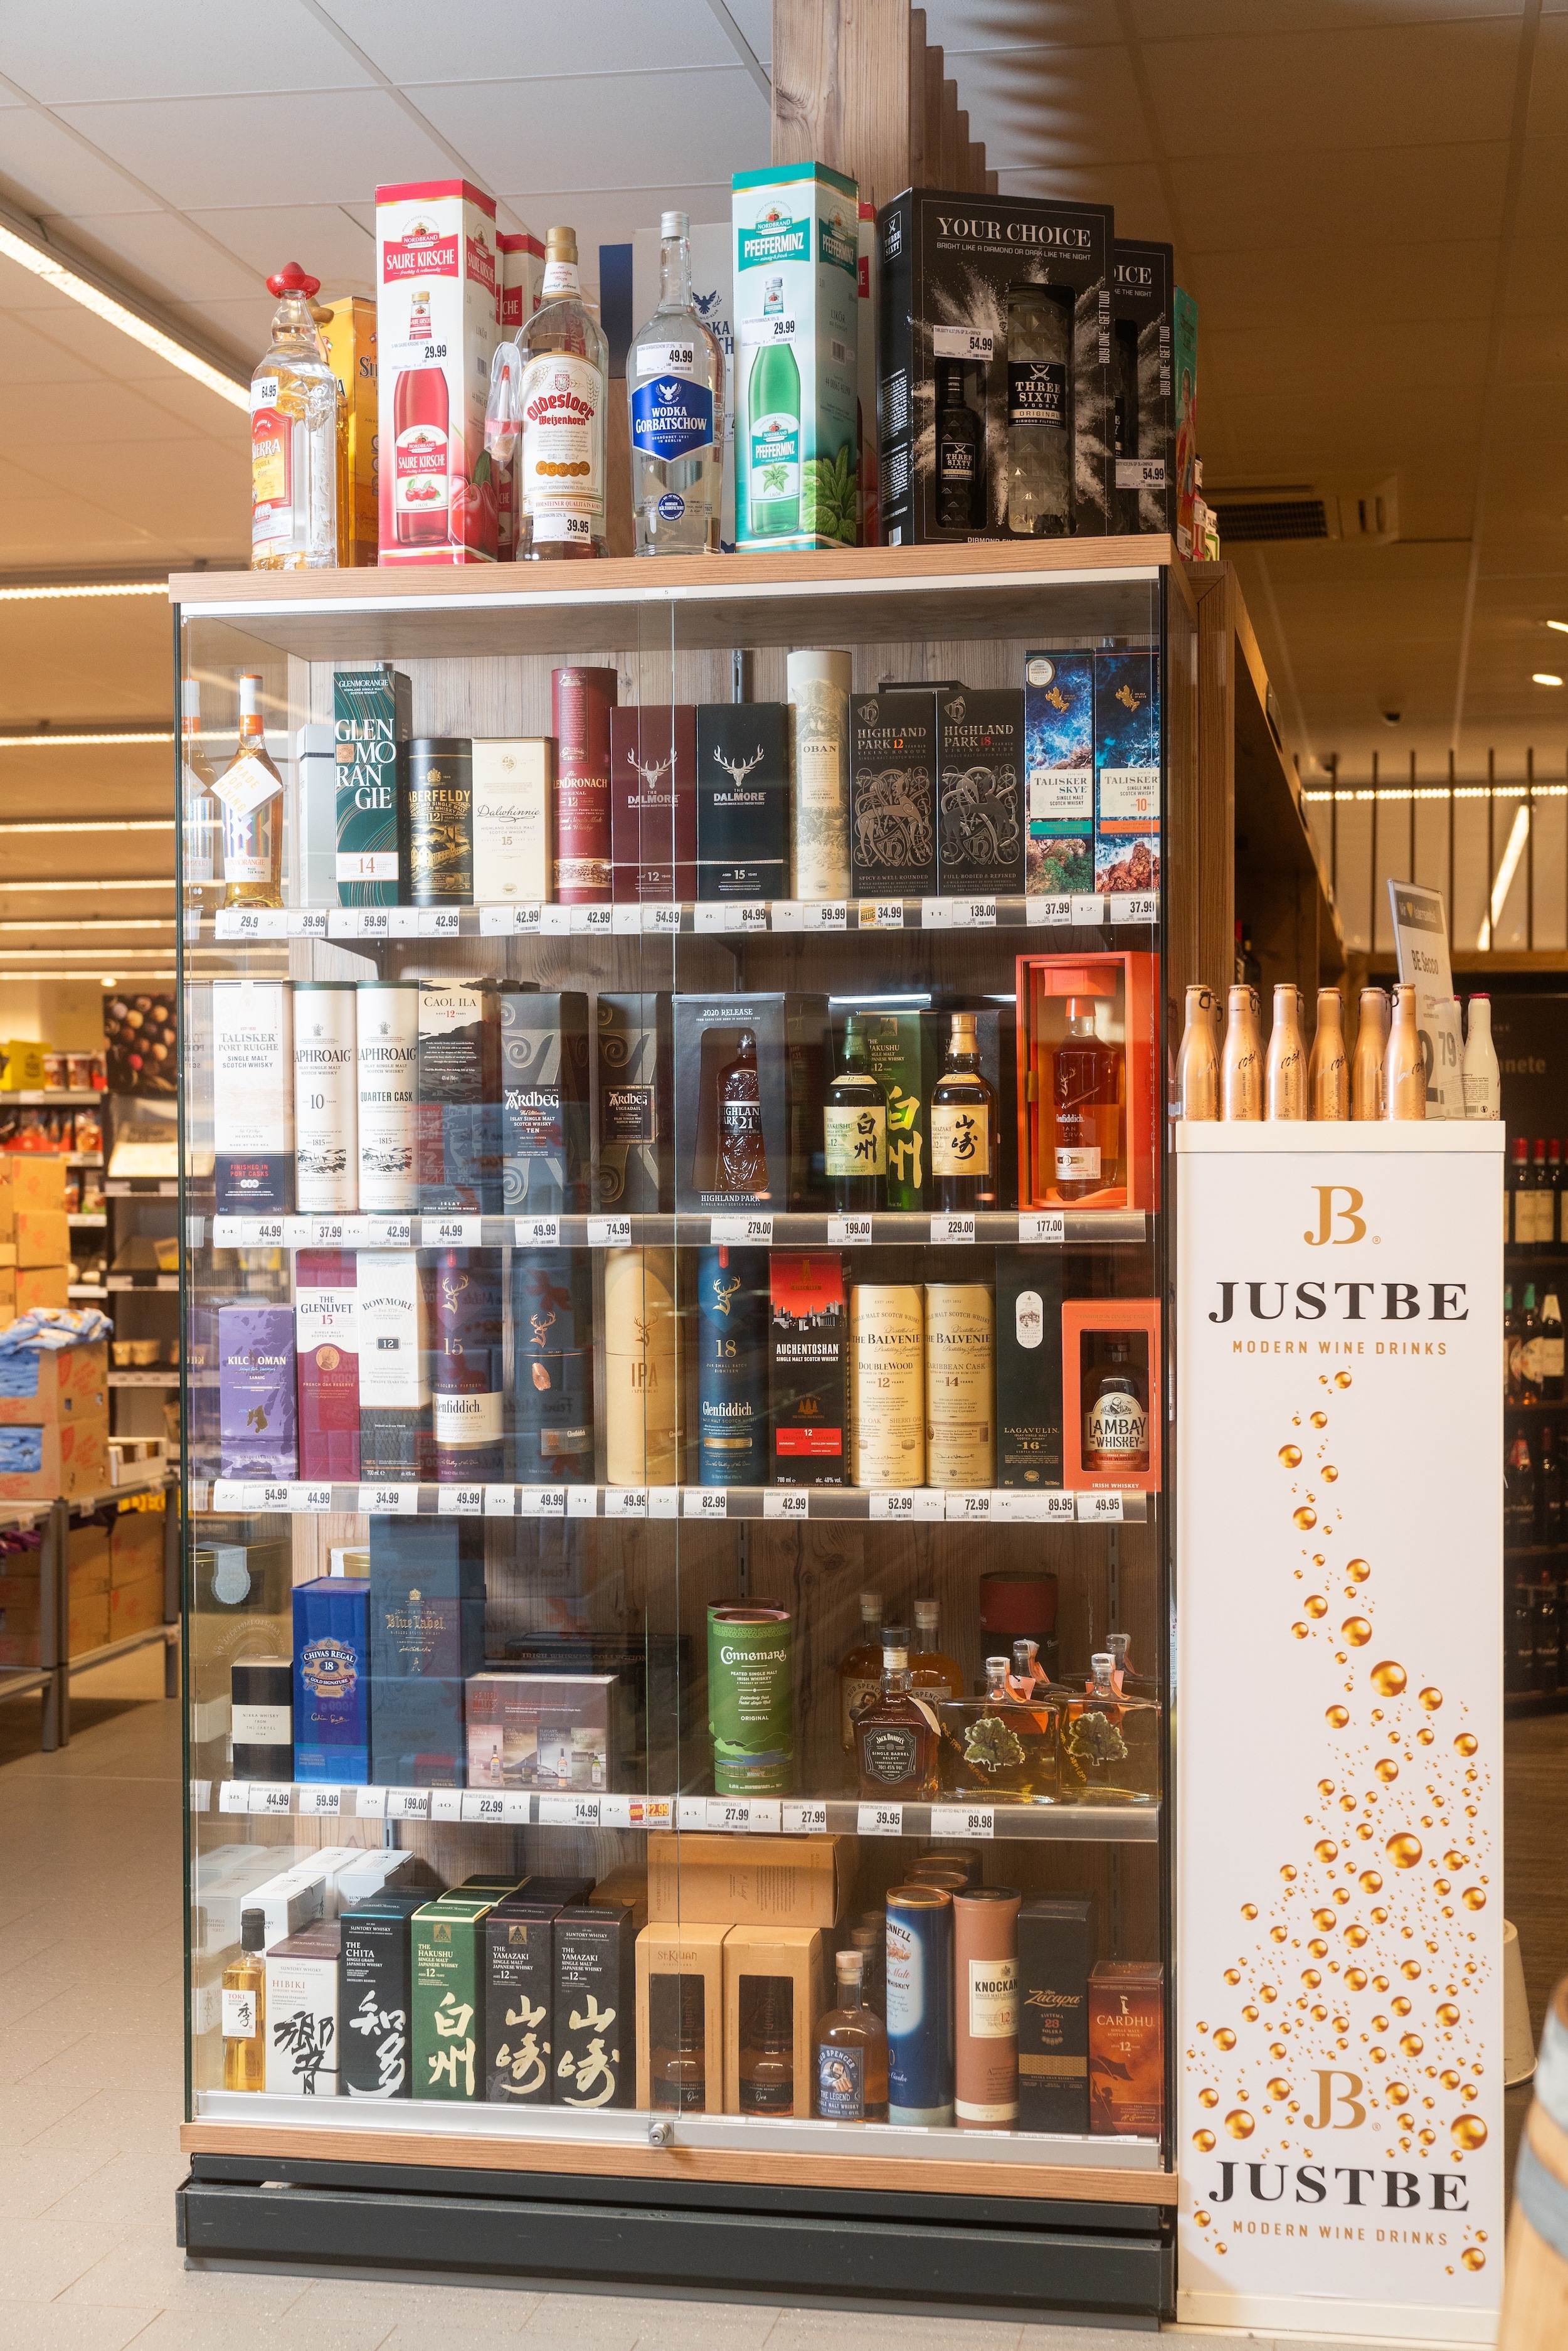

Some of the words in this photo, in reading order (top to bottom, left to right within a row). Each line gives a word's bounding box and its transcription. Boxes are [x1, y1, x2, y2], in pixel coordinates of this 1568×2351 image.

[757, 220, 791, 230] NORDBRAND
[937, 218, 1001, 240] YOUR
[1007, 224, 1091, 247] CHOICE
[403, 235, 438, 243] NORDBRAND
[744, 233, 803, 258] PFEFFERMINZ
[985, 245, 1013, 253] DIAMOND
[1073, 252, 1091, 260] NIGHT
[387, 253, 415, 269] SAURE
[418, 250, 455, 266] KIRSCHE
[1099, 290, 1110, 307] TWO
[1099, 308, 1110, 324] GET
[775, 321, 795, 335] 29.99
[1099, 329, 1110, 346] ONE
[970, 337, 992, 351] 54.99
[425, 345, 447, 358] 29.99
[669, 350, 692, 364] 49.99
[1099, 346, 1110, 364] BUY
[262, 385, 277, 399] 64.95
[1016, 381, 1061, 393] THREE
[1019, 392, 1059, 404] SIXTY
[652, 407, 687, 417] WODKA
[636, 418, 707, 433] GORBATSCHOW
[567, 519, 589, 533] 39.95
[335, 719, 393, 741] GLEN
[857, 728, 926, 738] HIGHLAND
[858, 740, 890, 749] PARK
[893, 739, 904, 748] 12
[355, 742, 396, 763] MO
[336, 766, 381, 787] RAN
[1034, 778, 1087, 786] TALISKER
[355, 787, 393, 809] GIE
[714, 792, 765, 802] DALMORE
[358, 857, 375, 873] 14
[822, 909, 845, 920] 59.99
[878, 907, 901, 918] 34.99
[970, 906, 995, 917] 139.00
[1046, 903, 1069, 915] 37.99
[743, 910, 765, 921] 84.99
[303, 916, 325, 928] 39.99
[435, 916, 458, 928] 42.99
[424, 997, 455, 1007] CAOL
[458, 997, 476, 1006] ILA
[220, 1033, 275, 1042] TALISKER
[310, 1095, 324, 1108] 10
[361, 1091, 391, 1102] QUARTER
[394, 1091, 413, 1101] CASK
[260, 1226, 282, 1237] 44.99
[387, 1226, 409, 1237] 42.99
[533, 1224, 556, 1236] 49.99
[748, 1223, 771, 1234] 279.00
[845, 1223, 870, 1234] 199.00
[948, 1222, 973, 1233] 229.00
[362, 1298, 414, 1311] BOWMORE
[1208, 1282, 1468, 1323] JUSTBE
[321, 1315, 333, 1324] 15
[852, 1335, 865, 1344] THE
[868, 1334, 921, 1344] BALVENIE
[443, 1337, 464, 1356] 15
[716, 1339, 736, 1357] 18
[776, 1344, 839, 1355] AUCHENTOSHAN
[1233, 1341, 1308, 1354] MODERN
[1319, 1341, 1365, 1354] WINE
[1376, 1342, 1447, 1355] DRINKS
[1089, 1416, 1145, 1435] LAMBAY
[1096, 1436, 1140, 1447] WHISKEY
[265, 1489, 287, 1500] 54.99
[376, 1492, 398, 1504] 34.99
[541, 1494, 563, 1505] 49.99
[702, 1496, 725, 1508] 82.99
[783, 1498, 806, 1509] 42.99
[888, 1499, 912, 1510] 52.99
[1048, 1499, 1072, 1510] 89.95
[1096, 1499, 1119, 1510] 49.95
[304, 1652, 329, 1662] CHIVAS
[331, 1650, 354, 1662] REGAL
[325, 1662, 334, 1670] 18
[267, 1794, 289, 1805] 44.99
[404, 1798, 427, 1810] 199.00
[575, 1805, 597, 1817] 14.99
[646, 1803, 669, 1817] 22.99
[726, 1808, 749, 1821] 27.99
[877, 1812, 900, 1825] 39.95
[968, 1815, 992, 1828] 89.98
[346, 1949, 374, 1958] CHITA
[426, 1968, 435, 1977] 12
[272, 1980, 305, 1988] HIBIKI
[1096, 2015, 1154, 2027] CARDHU
[1209, 2162, 1470, 2212] JUSTBE
[1233, 2221, 1308, 2237] MODERN
[1319, 2226, 1365, 2241] WINE
[1377, 2230, 1448, 2246] DRINKS
